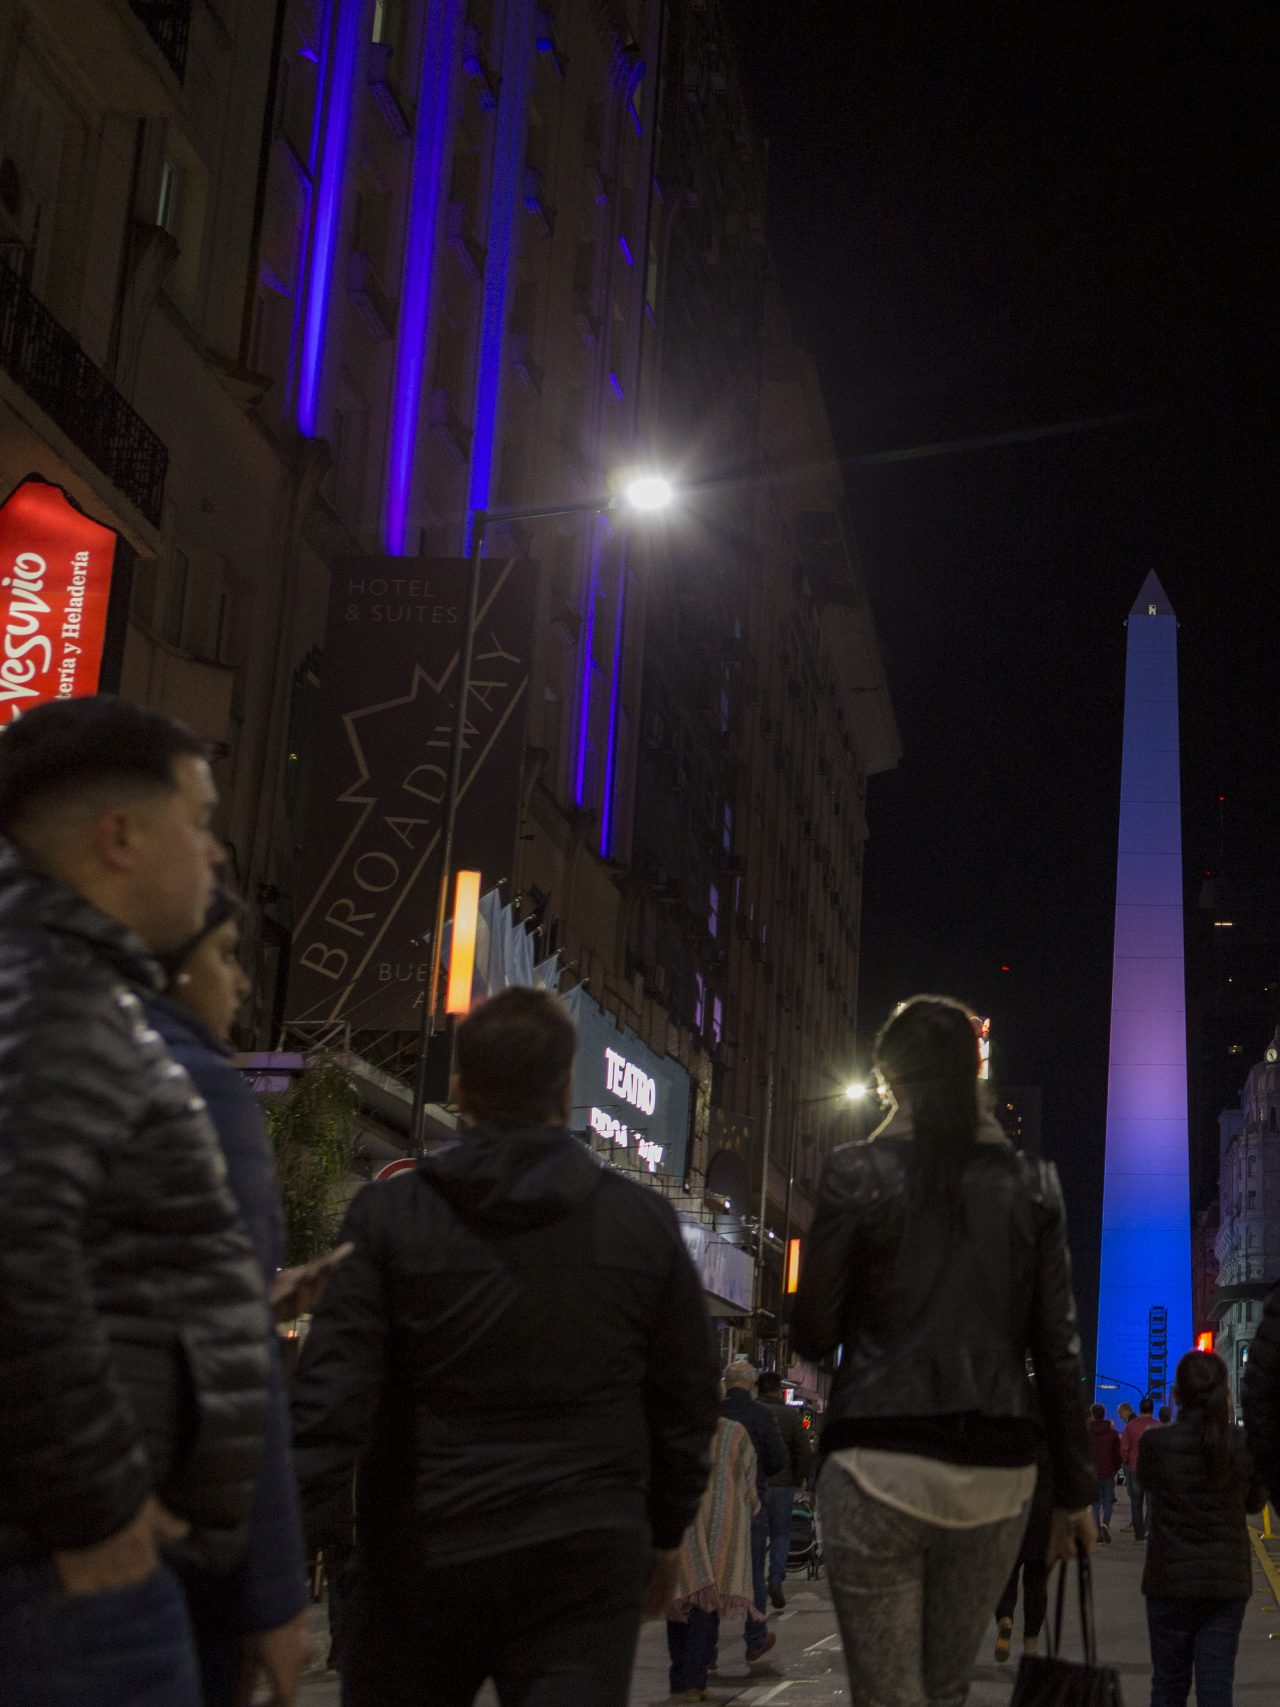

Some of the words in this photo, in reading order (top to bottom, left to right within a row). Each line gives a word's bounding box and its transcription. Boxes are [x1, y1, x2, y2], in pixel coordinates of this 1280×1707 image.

[60, 551, 90, 639] Heladería
[348, 578, 435, 598] HOTEL
[344, 604, 361, 622] &
[371, 603, 459, 624] SUITES
[63, 642, 81, 654] y
[54, 657, 78, 700] tería
[299, 632, 523, 981] BROADWAY
[379, 962, 428, 982] BUE
[605, 1047, 656, 1116] TEATRO
